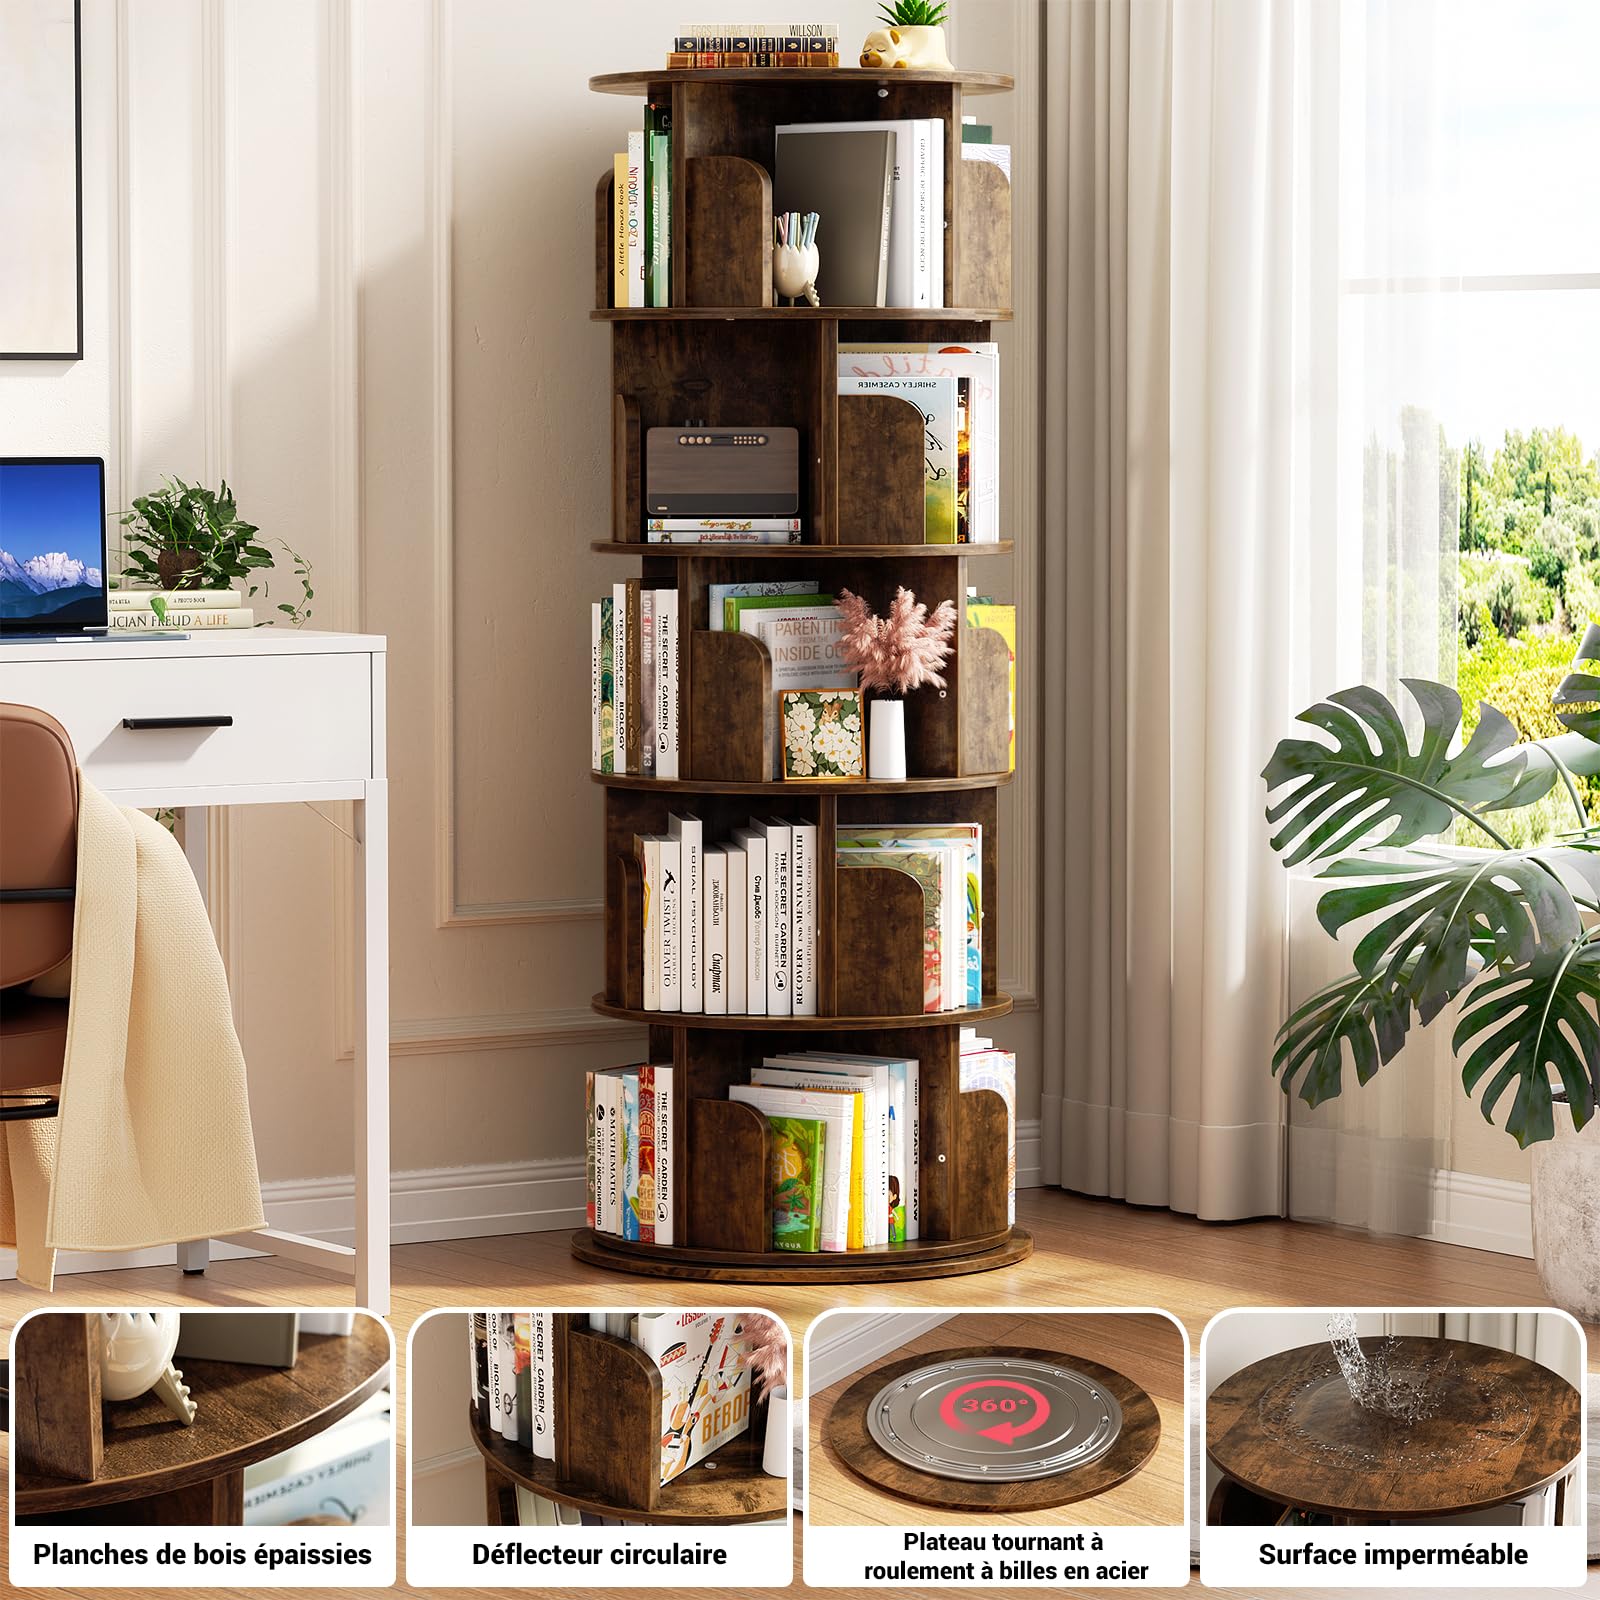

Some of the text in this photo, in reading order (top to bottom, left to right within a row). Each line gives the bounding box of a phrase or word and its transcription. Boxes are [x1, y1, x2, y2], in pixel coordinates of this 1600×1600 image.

[790, 25, 822, 37] WILLSON
[629, 219, 638, 238] ZOO
[619, 268, 624, 276] A
[109, 615, 146, 628] UCIAN
[194, 615, 202, 625] A
[207, 614, 229, 625] LIFE
[644, 594, 652, 665] LOVE IN ARMS
[775, 646, 820, 662] INSIDE
[619, 675, 623, 688] OF
[644, 745, 652, 767] EX3
[753, 895, 762, 919] Джобс
[709, 953, 723, 993] Спартак
[492, 1338, 497, 1351] OF
